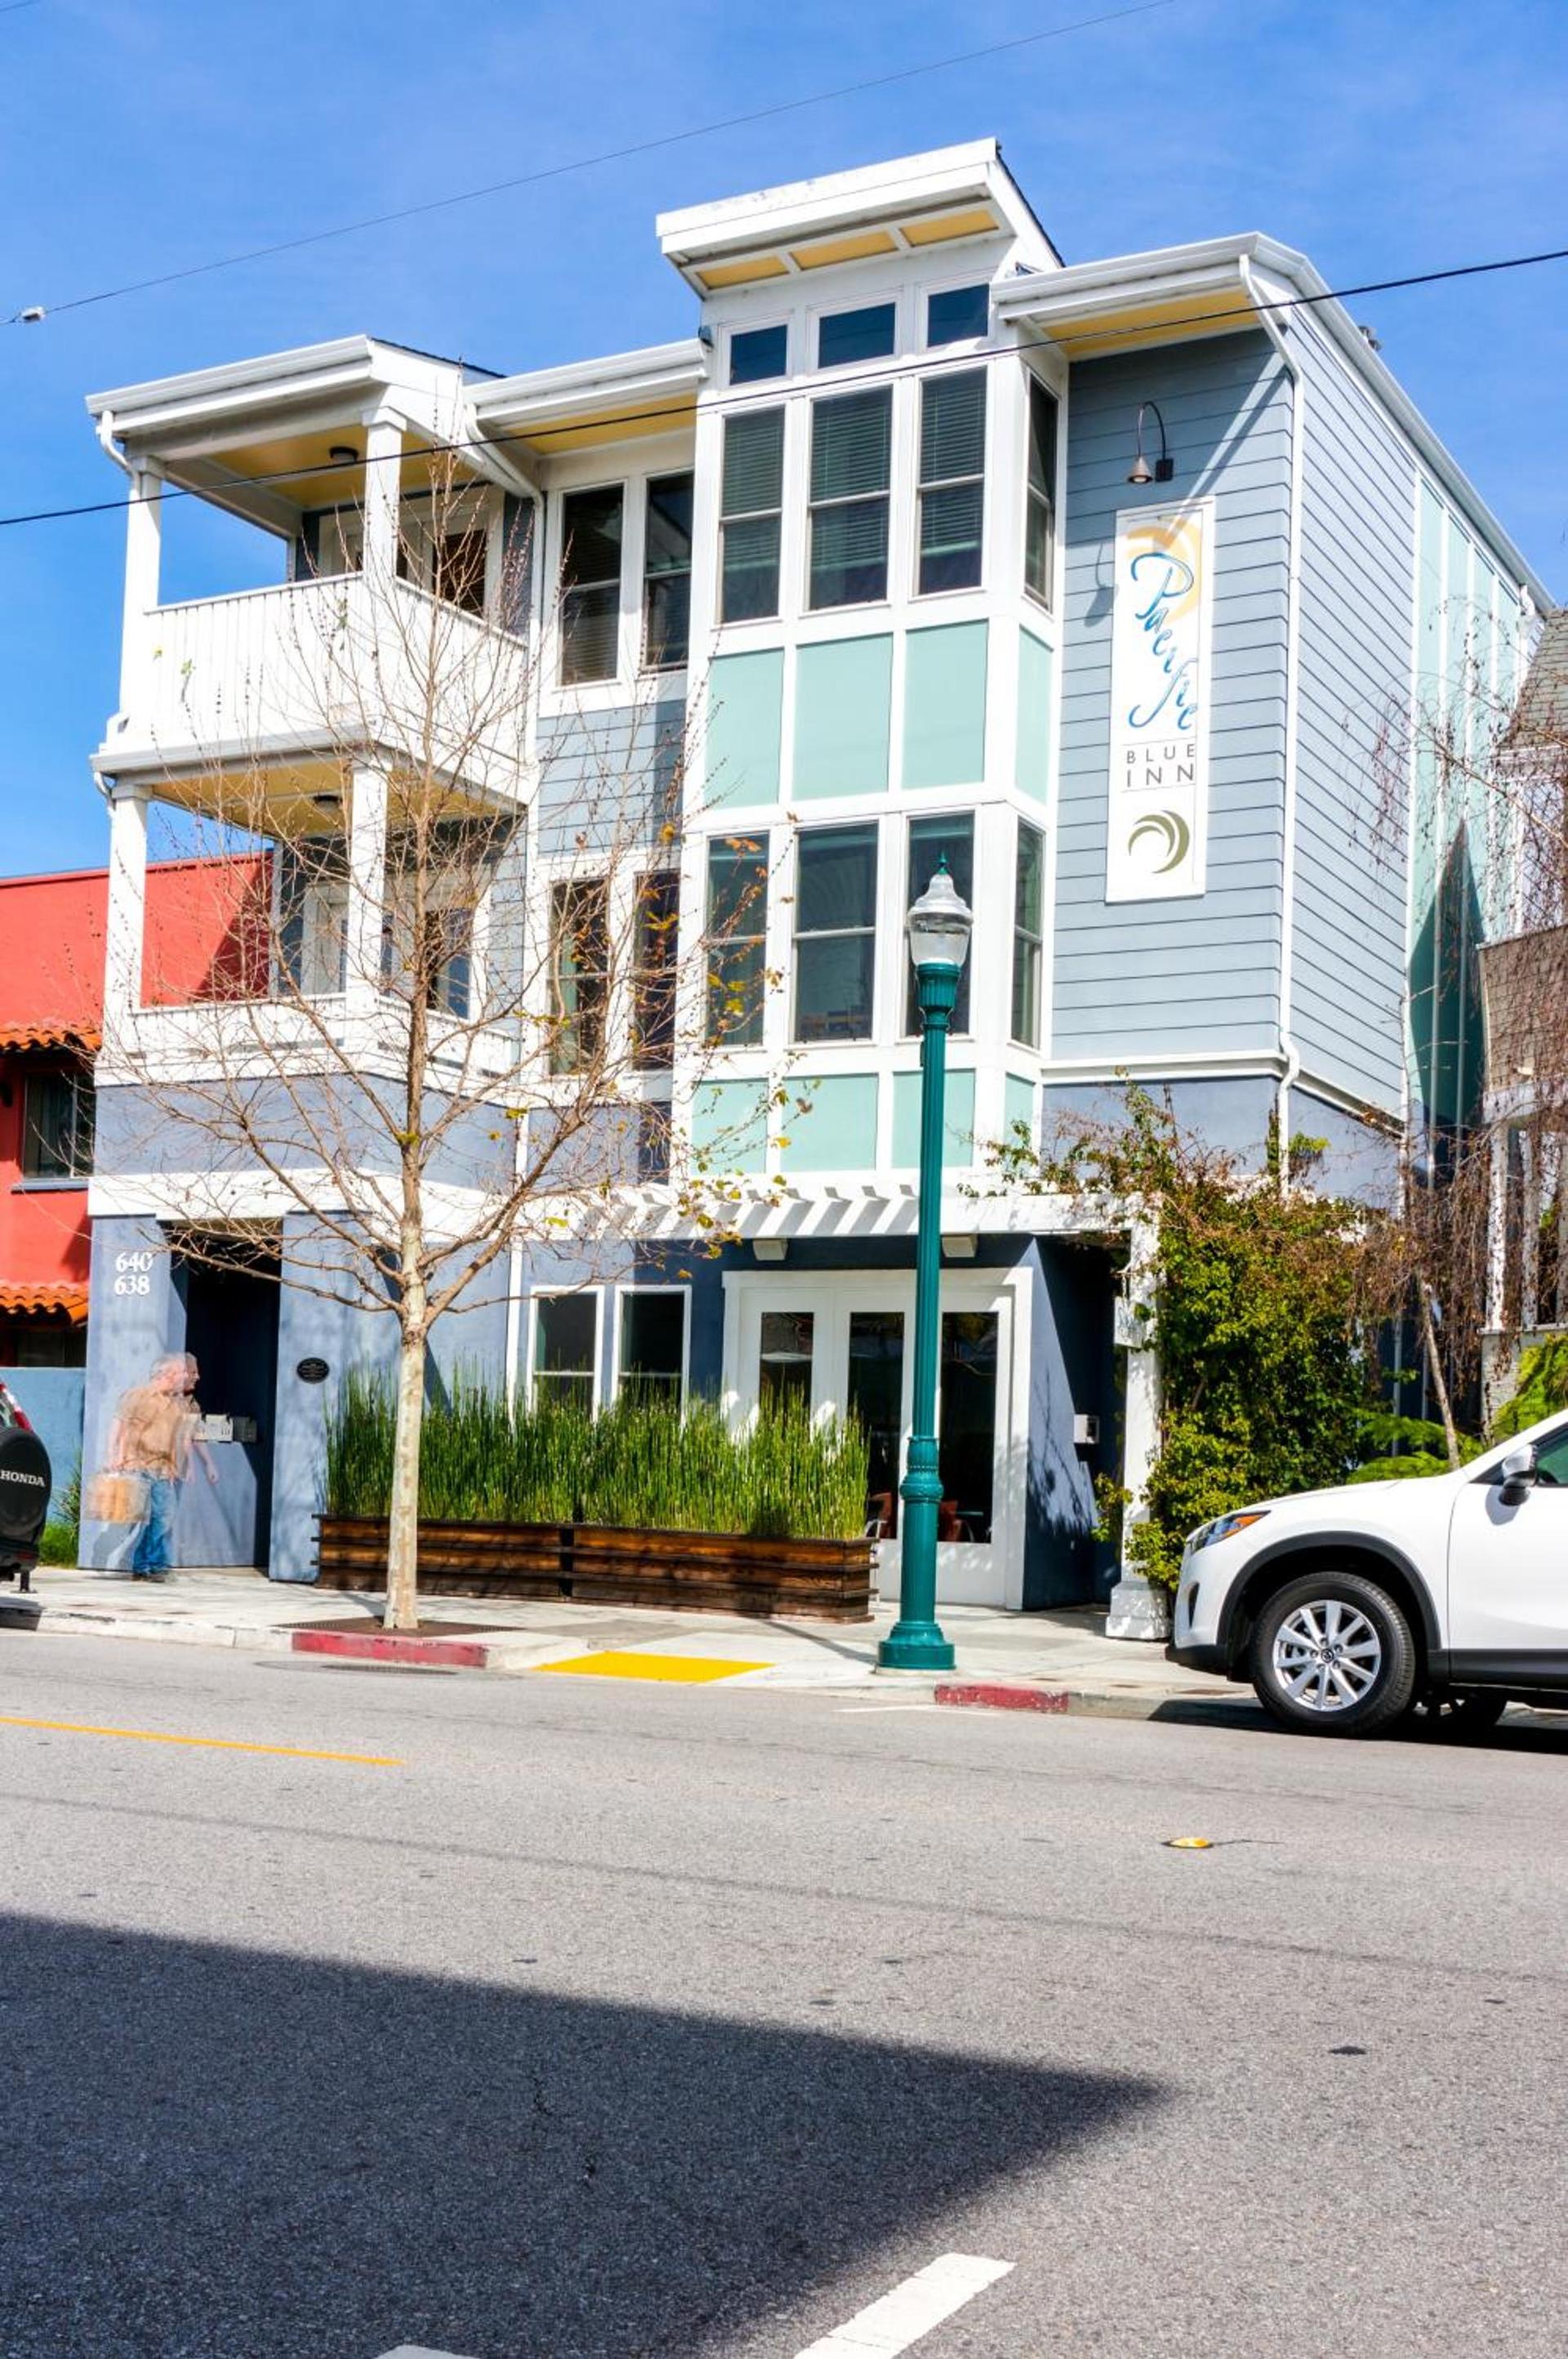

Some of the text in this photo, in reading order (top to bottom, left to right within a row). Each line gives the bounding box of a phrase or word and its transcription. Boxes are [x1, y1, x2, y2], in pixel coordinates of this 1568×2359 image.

[1129, 552, 1198, 730] Pacific
[1127, 743, 1195, 764] BLUE
[1127, 763, 1193, 787] INN
[116, 1251, 154, 1273] 640
[114, 1275, 150, 1295] 638
[0, 1469, 46, 1487] HONDA
